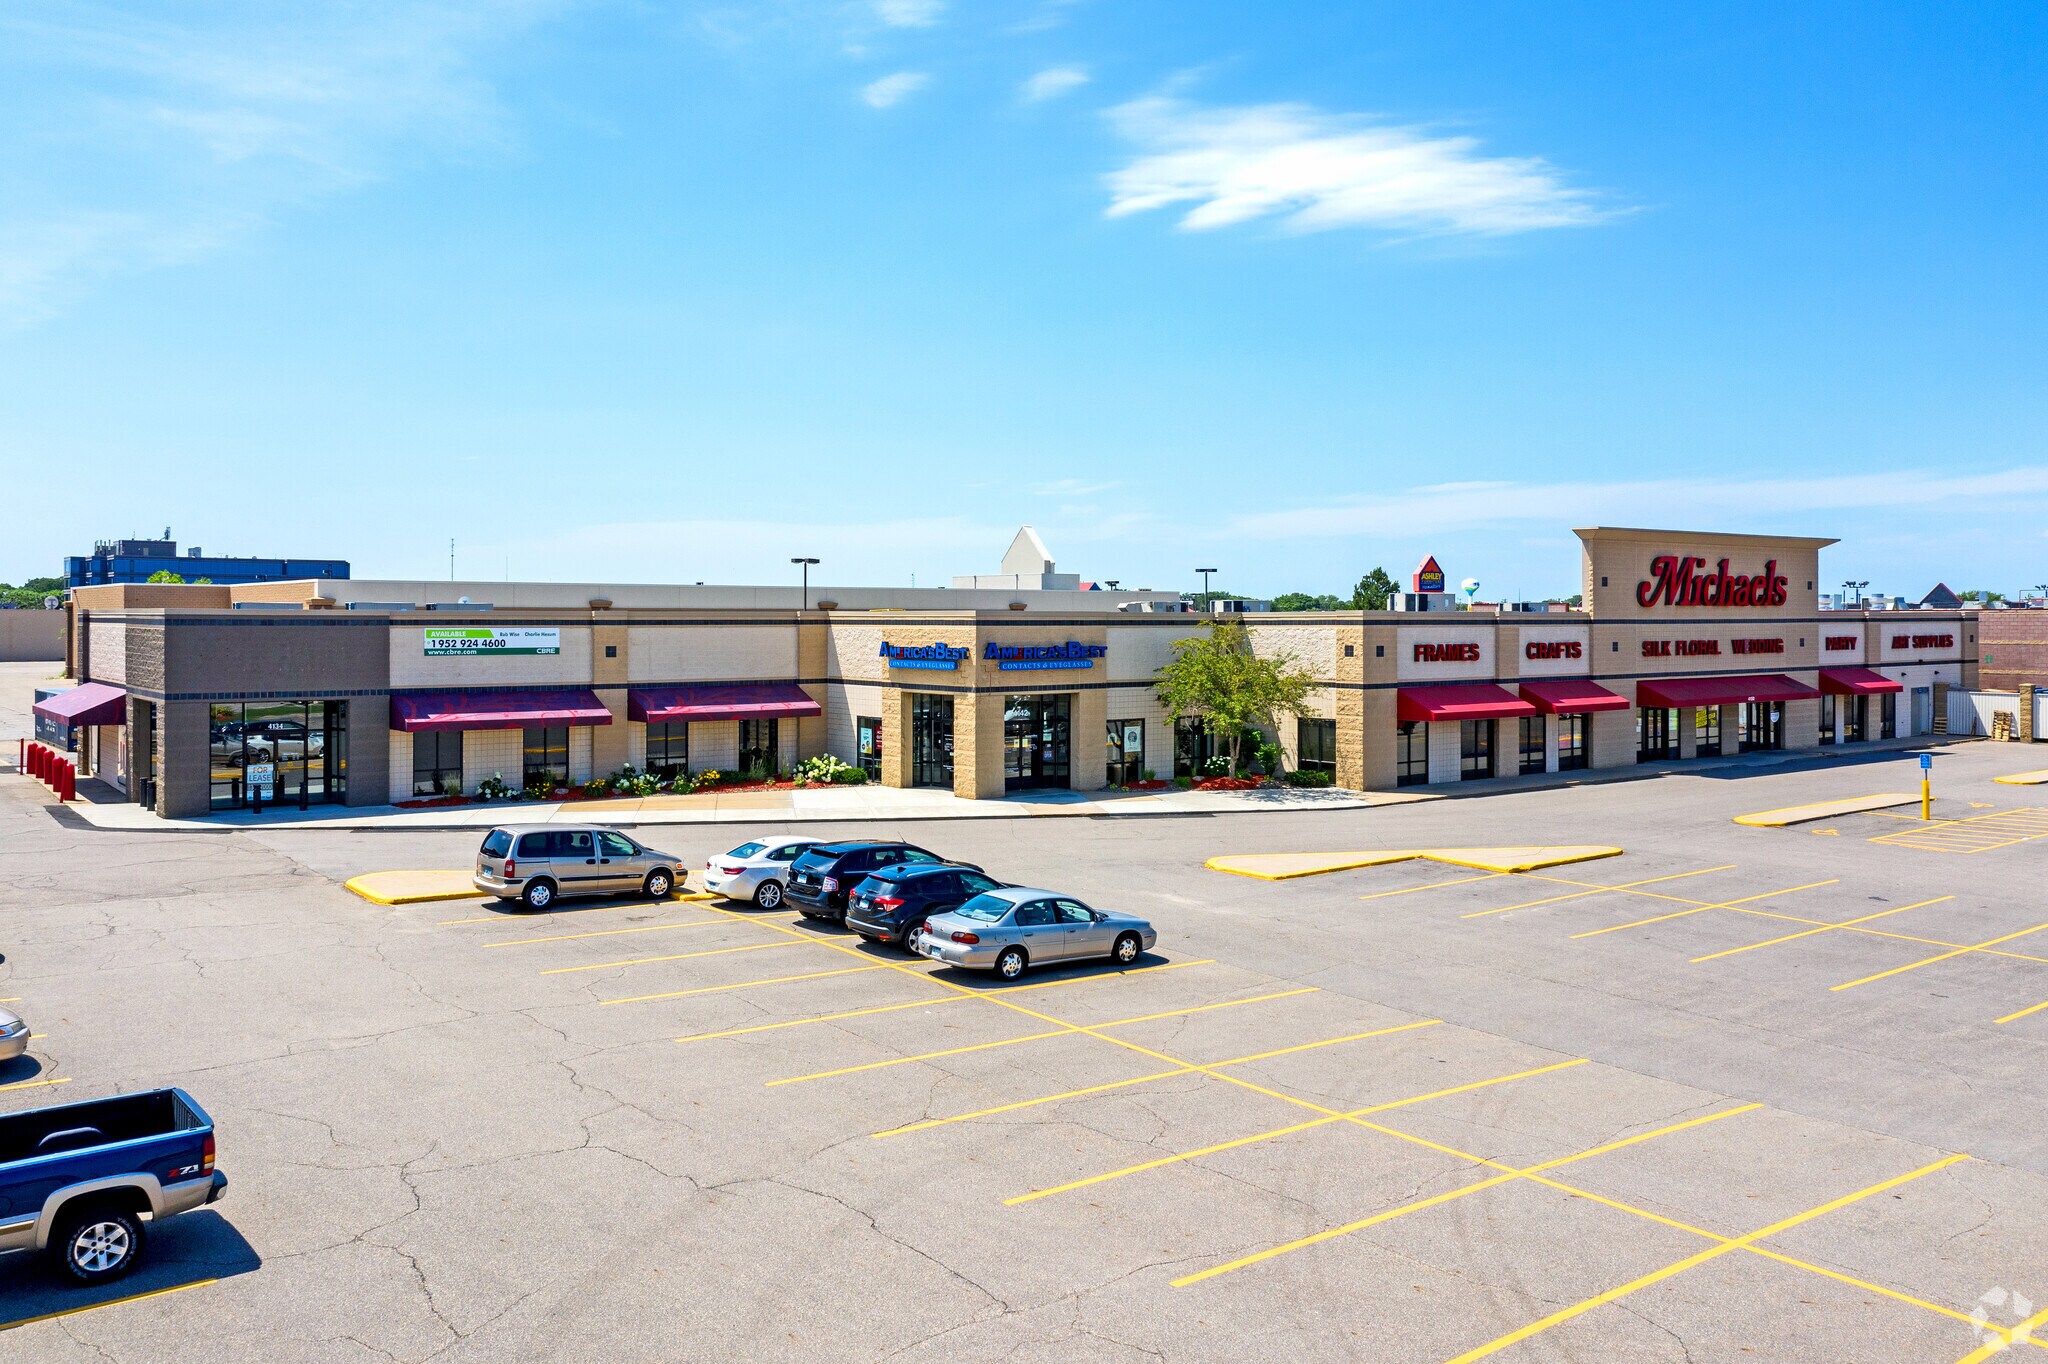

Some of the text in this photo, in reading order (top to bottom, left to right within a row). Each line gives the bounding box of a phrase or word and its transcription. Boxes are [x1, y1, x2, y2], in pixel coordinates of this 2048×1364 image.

[1637, 556, 1788, 608] Michaels
[431, 639, 506, 647] 1 952 924 4600
[1642, 638, 1784, 657] SILK FLORAL WEDDING
[1826, 637, 1857, 650] PARTY
[1892, 635, 1953, 649] ART SUPPLIES
[1414, 643, 1480, 662] FRAMES
[1525, 642, 1583, 659] CRAFTS
[1002, 662, 1041, 670] CONTACTS
[1049, 660, 1093, 668] EYEGLASSES
[167, 1164, 199, 1178] Z71
